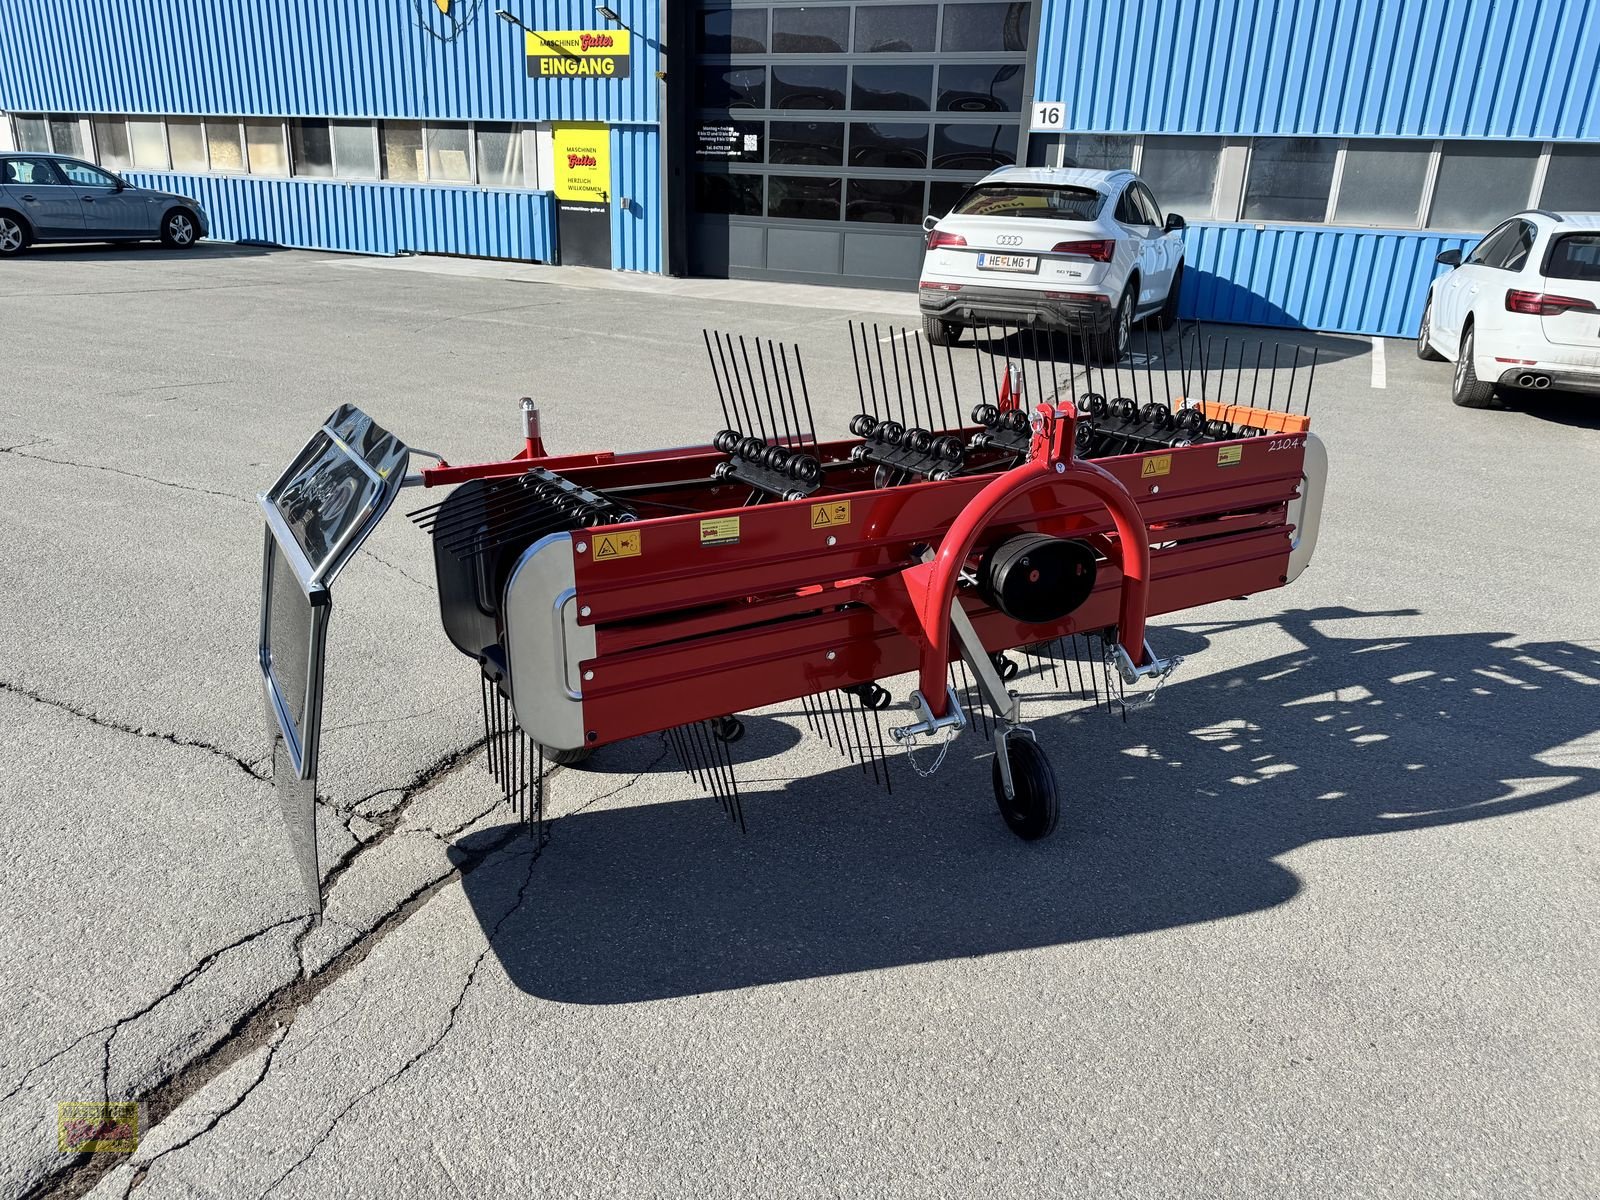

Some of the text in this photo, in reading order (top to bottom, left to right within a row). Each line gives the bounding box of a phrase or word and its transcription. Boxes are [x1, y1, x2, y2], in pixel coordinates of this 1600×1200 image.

[540, 39, 580, 47] MASCHINEN
[540, 57, 615, 75] EINGANG
[1039, 107, 1060, 124] 16
[989, 255, 1031, 269] HE LMG 1
